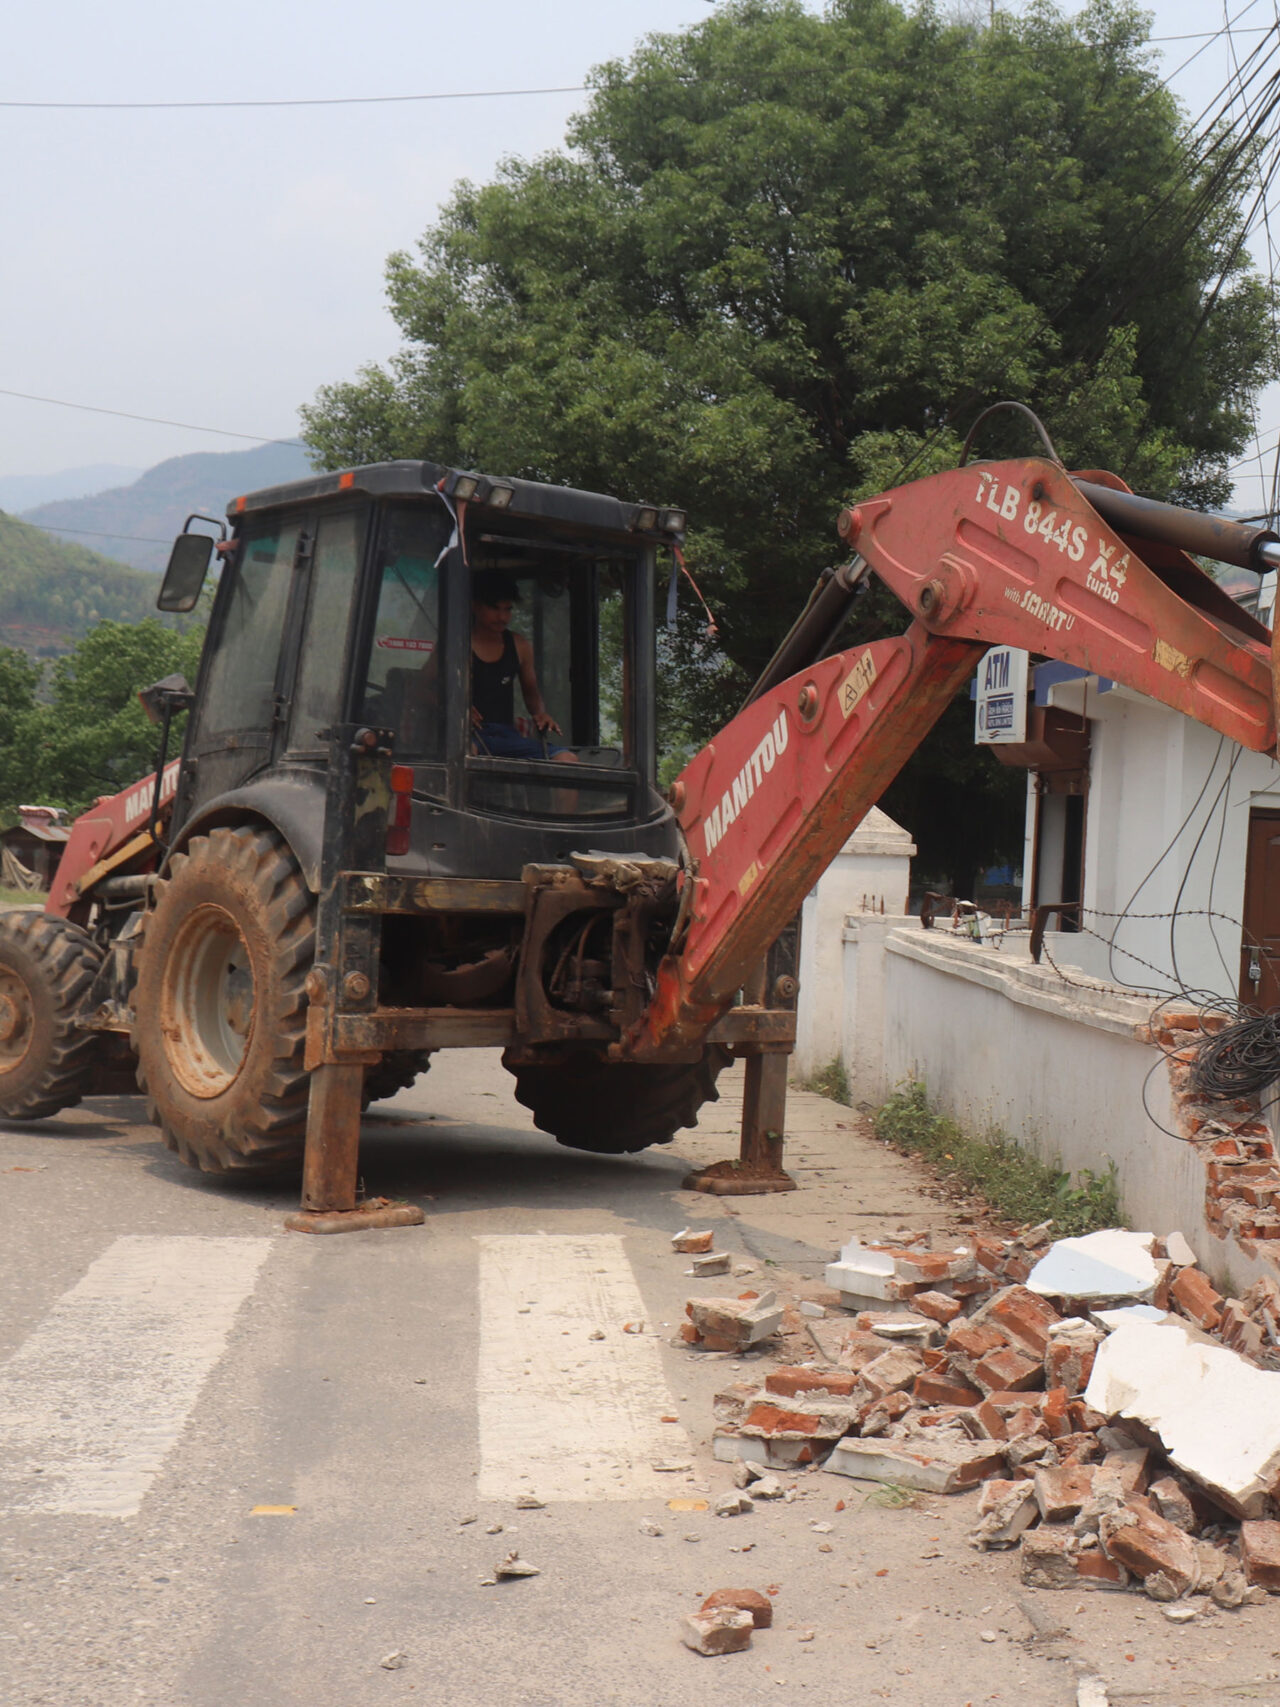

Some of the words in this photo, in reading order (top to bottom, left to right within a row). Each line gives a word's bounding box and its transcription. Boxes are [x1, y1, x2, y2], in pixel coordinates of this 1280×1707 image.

[1023, 501, 1088, 562] 844S
[1089, 538, 1131, 589] X4
[1004, 586, 1021, 605] with
[1086, 571, 1120, 605] turbo
[984, 651, 1010, 691] ATM
[703, 709, 789, 857] MANITOU
